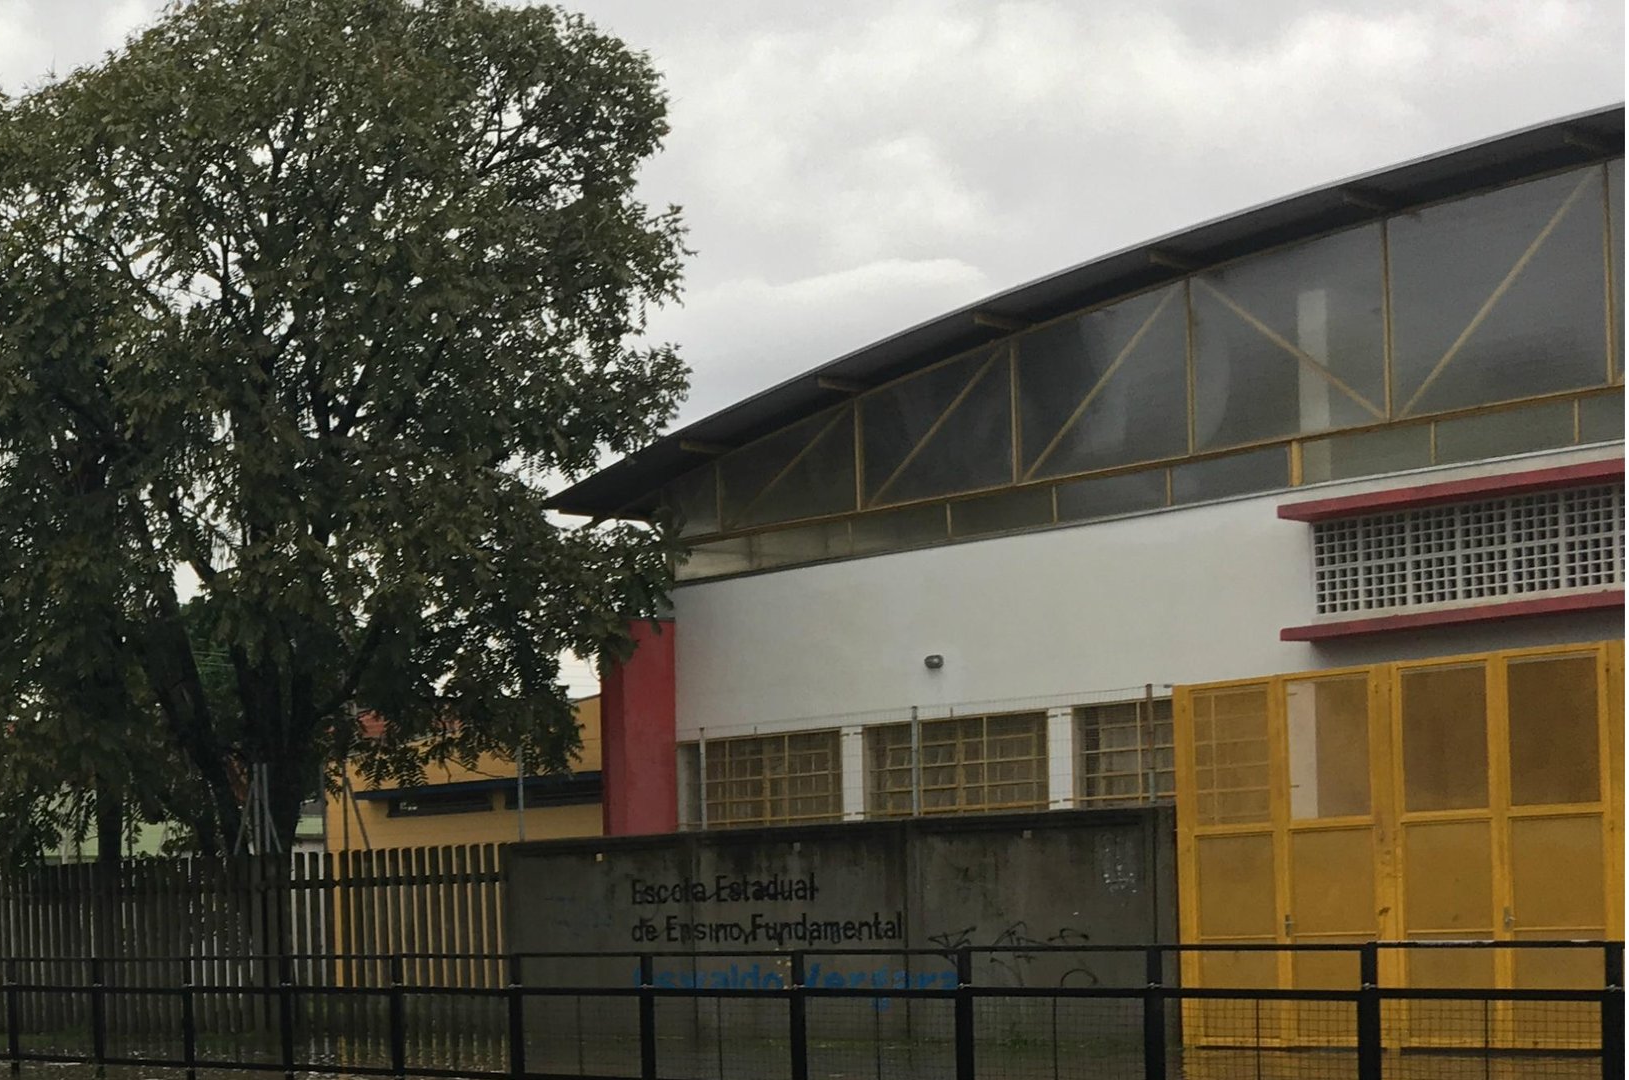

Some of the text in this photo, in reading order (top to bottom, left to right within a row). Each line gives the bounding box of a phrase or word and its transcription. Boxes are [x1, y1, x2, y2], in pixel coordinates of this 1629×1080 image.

[631, 872, 818, 905] Escola Estadual
[631, 917, 658, 943] de
[666, 915, 742, 944] Ensino
[752, 911, 903, 943] Fundamental
